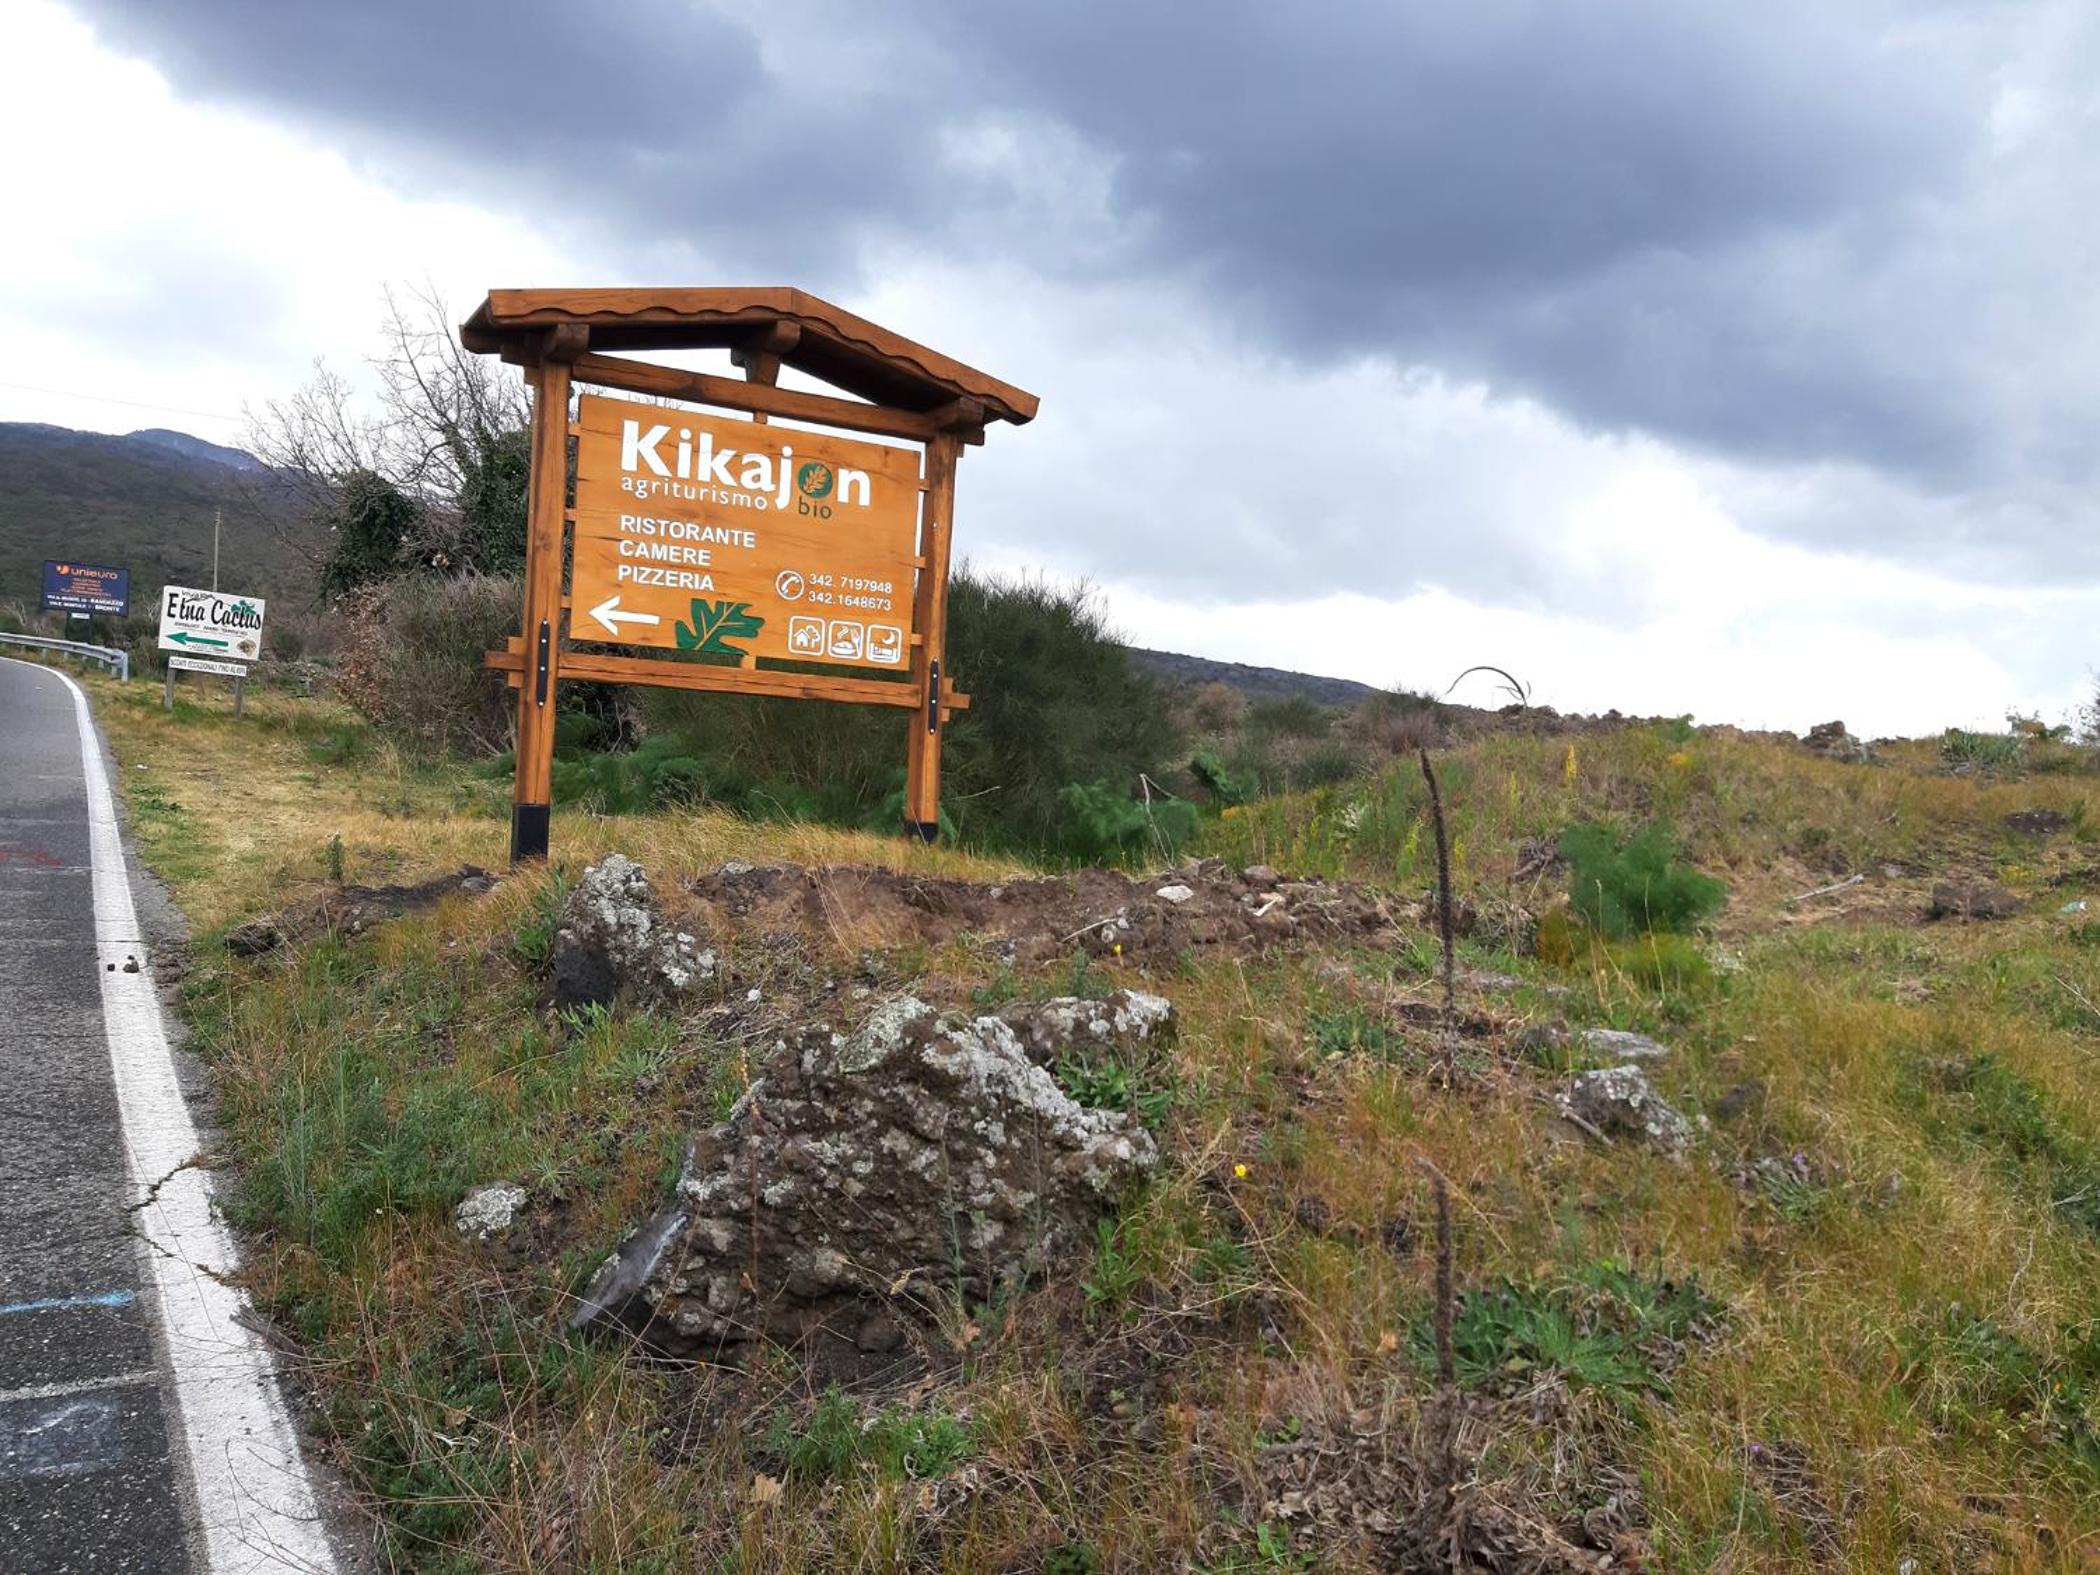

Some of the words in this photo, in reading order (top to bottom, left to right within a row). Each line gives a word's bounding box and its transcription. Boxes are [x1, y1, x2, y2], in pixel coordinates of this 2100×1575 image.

[621, 476, 768, 510] agriturismo
[798, 496, 832, 519] bio
[620, 514, 756, 548] RISTORANTE
[619, 540, 712, 567] CAMERE
[71, 567, 118, 580] unieuro
[618, 564, 715, 592] PIZZERIA
[167, 592, 205, 622] Etna
[211, 600, 261, 630] Cactus
